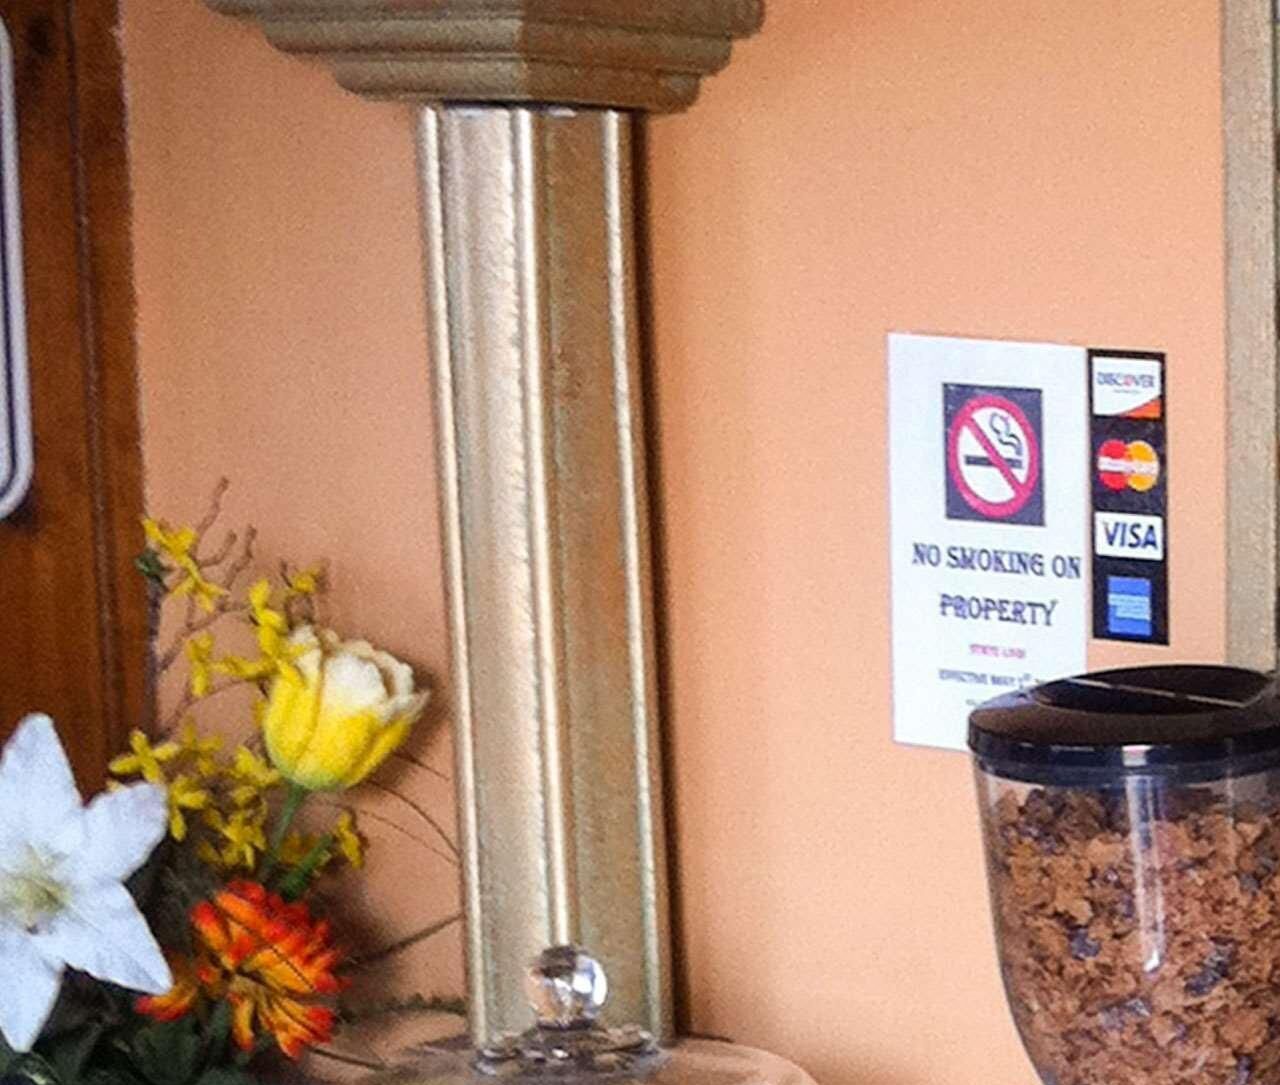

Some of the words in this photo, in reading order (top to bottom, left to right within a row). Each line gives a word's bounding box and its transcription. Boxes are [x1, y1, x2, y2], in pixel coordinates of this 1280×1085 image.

[1097, 371, 1155, 388] DISCOVER
[1103, 521, 1158, 550] VISA
[912, 543, 941, 567] NO
[946, 545, 1045, 577] SMOKING
[1052, 555, 1081, 579] ON
[939, 593, 1058, 626] PROPERTY
